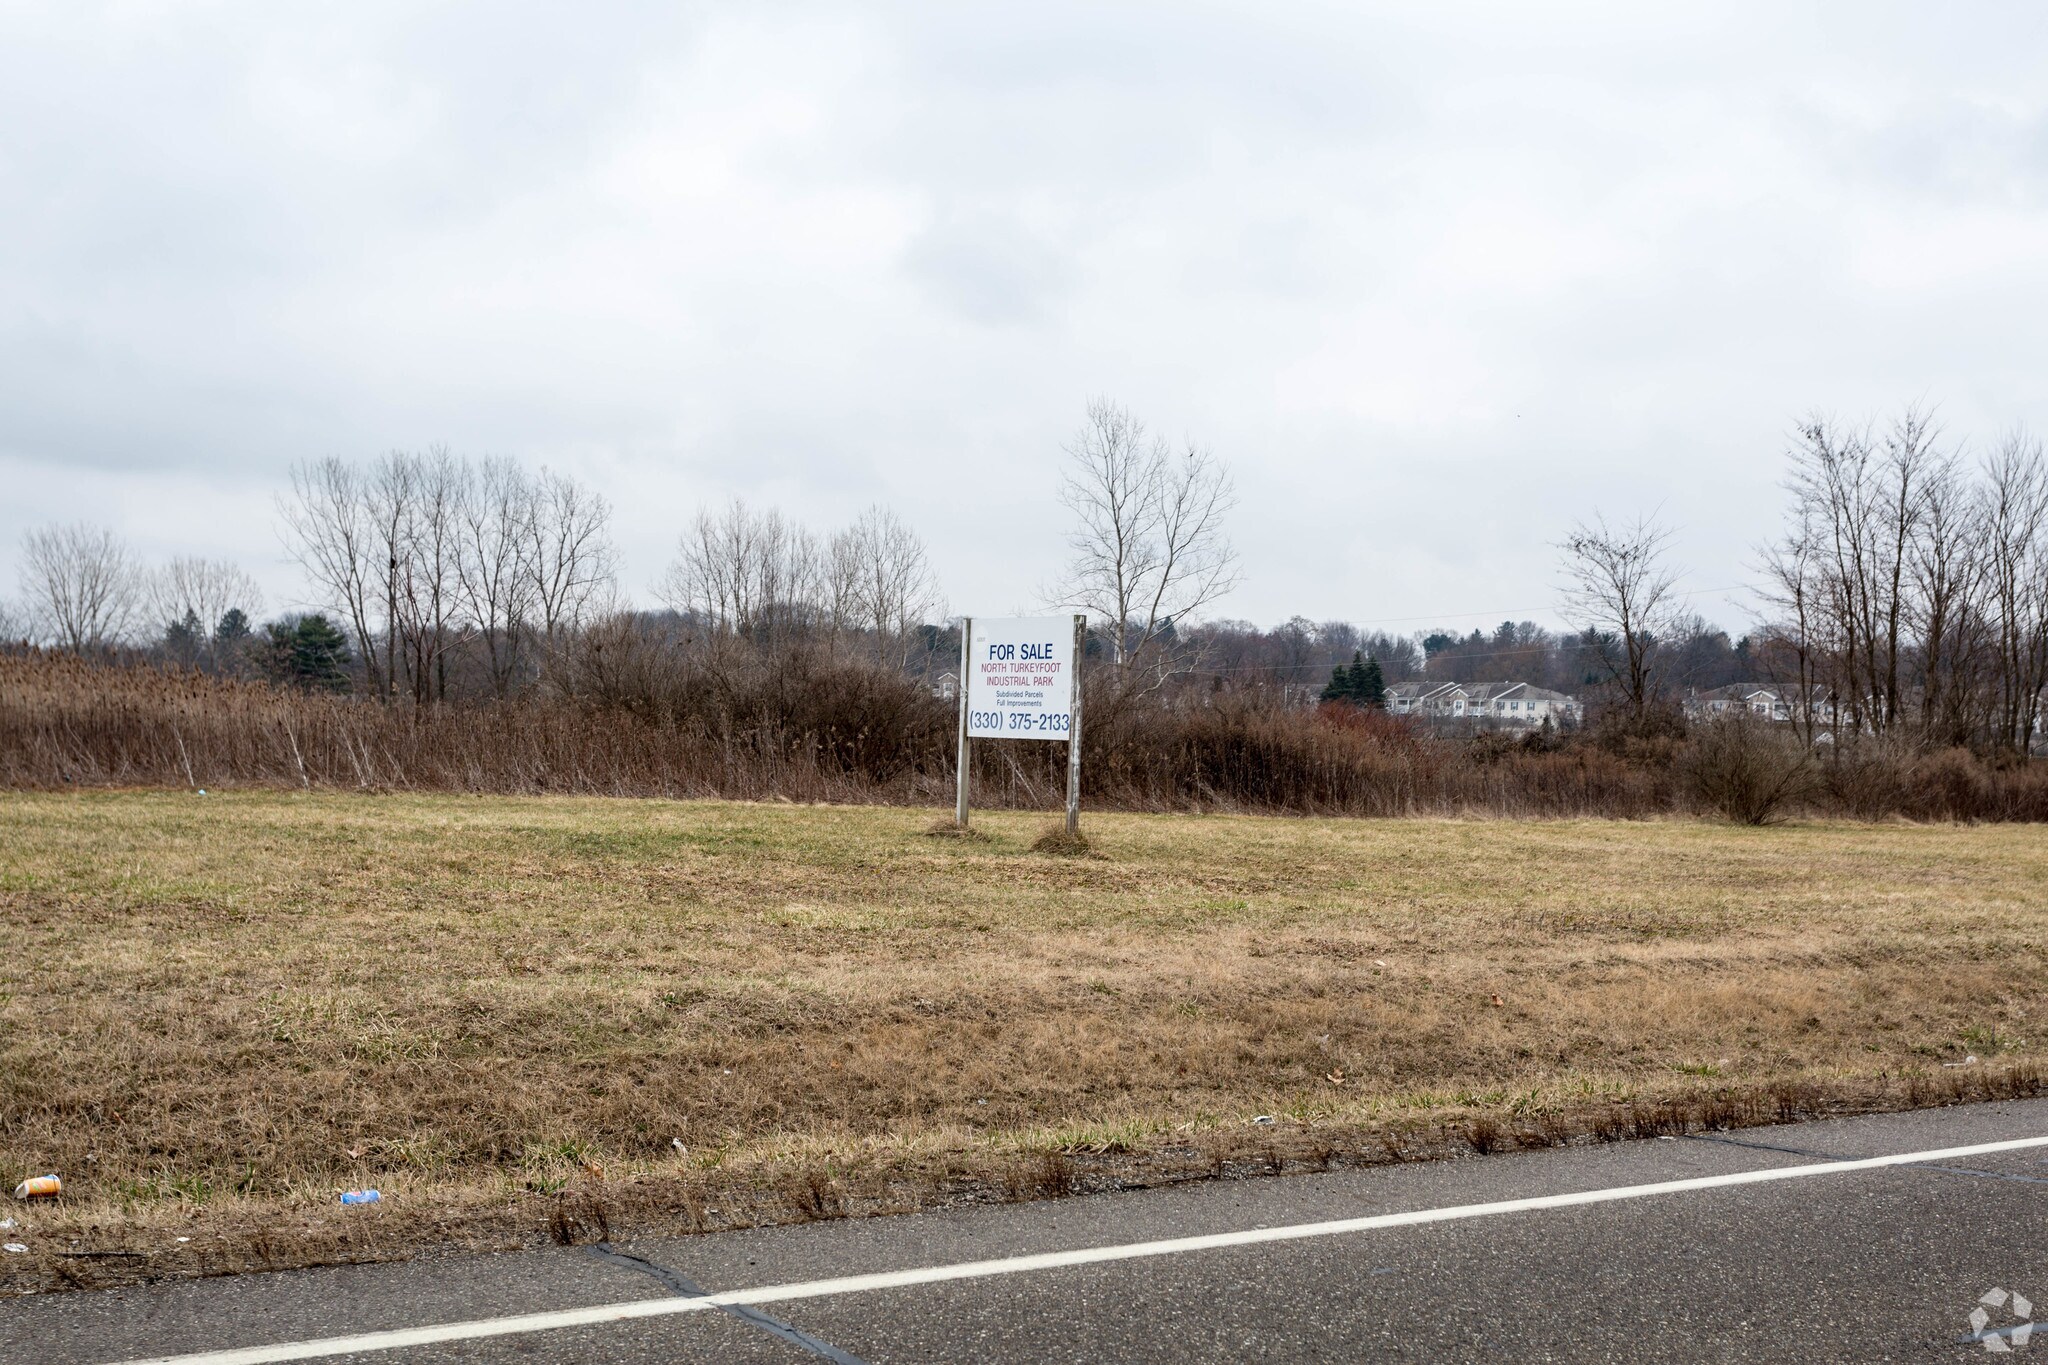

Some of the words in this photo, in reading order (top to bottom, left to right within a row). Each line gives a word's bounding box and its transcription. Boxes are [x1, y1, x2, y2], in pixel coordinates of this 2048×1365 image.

[989, 644, 1015, 660] FOR
[1020, 643, 1053, 660] SALE
[981, 663, 1007, 673] NORTH
[1010, 662, 1061, 673] TURKEYFOOT
[986, 676, 1030, 686] INDUSTRIAL
[1033, 676, 1054, 686] PARK
[996, 690, 1023, 698] Subdivided
[1025, 690, 1043, 698] Parcels
[1006, 699, 1042, 707] Improvements
[969, 710, 1003, 731] (330)
[1009, 712, 1070, 731] 375-2133
